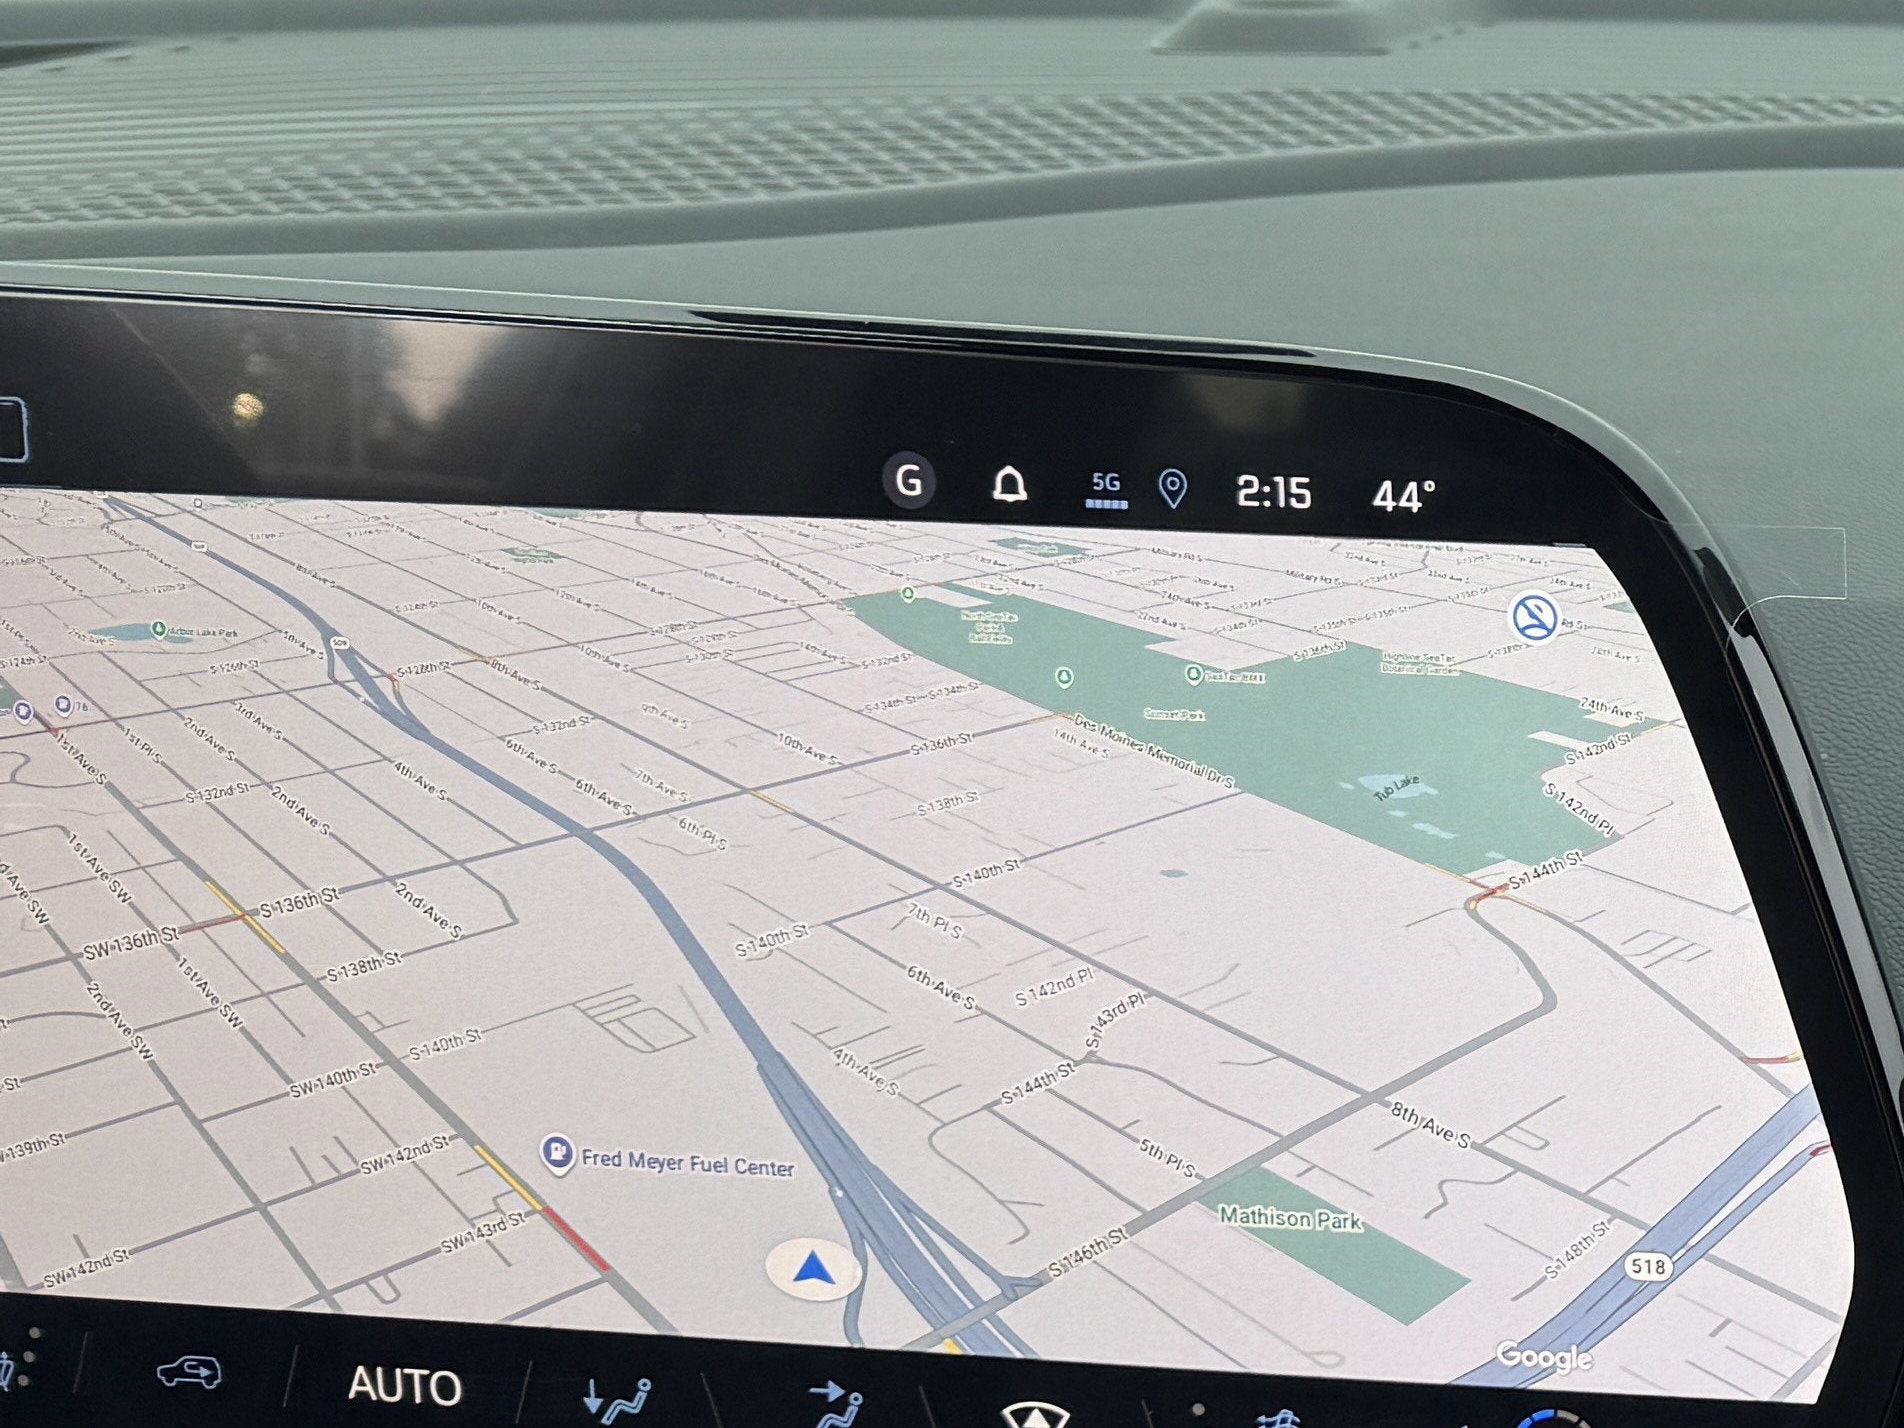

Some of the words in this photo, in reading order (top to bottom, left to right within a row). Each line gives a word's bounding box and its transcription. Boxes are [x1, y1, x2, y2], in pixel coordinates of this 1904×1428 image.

[897, 465, 920, 496] G
[1093, 473, 1120, 492] 5G
[1237, 475, 1311, 510] 2:15
[1372, 479, 1435, 513] 44°
[1581, 697, 1606, 713] 24th
[1611, 704, 1632, 718] Ave
[185, 718, 208, 738] 2nd
[205, 734, 226, 754] Ave
[924, 736, 955, 752] 136th
[957, 732, 972, 745] St
[1075, 714, 1096, 733] Des
[1100, 724, 1144, 752] Moines
[1148, 744, 1207, 777] Memorial
[1208, 768, 1223, 785] Dr
[1223, 776, 1234, 790] S
[1579, 740, 1616, 761] 142nd
[1617, 734, 1631, 746] St
[56, 733, 74, 758] 1st
[72, 750, 96, 776] Ave
[199, 784, 233, 801] 132nd
[237, 782, 249, 794] St
[394, 761, 414, 779] 4th
[414, 775, 436, 792] Ave
[575, 779, 596, 795] 6th
[598, 790, 621, 808] Ave
[1373, 786, 1395, 802] Tub
[1393, 775, 1420, 791] Lake
[271, 786, 297, 809] 2nd
[295, 806, 320, 828] Ave
[1557, 790, 1597, 825] 142nd
[1597, 818, 1616, 837] Pl
[679, 818, 699, 835] 6th
[703, 828, 716, 843] Pl
[69, 834, 88, 857] 1st
[86, 850, 109, 883] Ave
[108, 879, 131, 905] SW
[967, 864, 1002, 884] 140th
[1004, 859, 1021, 873] St
[1522, 859, 1564, 885] 144th
[1566, 851, 1584, 866] St
[7, 871, 29, 899] Ave
[27, 899, 50, 925] SW
[275, 891, 320, 915] 136th
[321, 887, 338, 904] St
[396, 883, 426, 910] 2nd
[424, 905, 450, 930] Ave
[907, 903, 930, 924] 7th
[934, 915, 949, 932] Pl
[83, 942, 109, 961] SW
[114, 930, 159, 953] 136th
[161, 926, 178, 942] St
[750, 930, 790, 952] 140th
[793, 924, 808, 938] St
[342, 957, 381, 978] 138th
[385, 952, 401, 966] St
[178, 956, 198, 982] 1st
[195, 973, 220, 1006] Ave
[219, 1003, 244, 1029] SW
[907, 965, 933, 987] 6th
[936, 982, 962, 1004] Ave
[1030, 977, 1075, 1001] 142nd
[1078, 967, 1093, 983] Pl
[87, 981, 112, 1011] 2nd
[108, 1007, 133, 1038] Ave
[132, 1035, 154, 1061] SW
[1089, 1003, 1127, 1036] 143rd
[1128, 993, 1144, 1009] Pl
[424, 1036, 463, 1057] 140th
[465, 1029, 482, 1043] St
[289, 1083, 313, 1099] SW
[317, 1068, 357, 1091] 140th
[358, 1062, 376, 1076] St
[832, 1047, 857, 1069] 4th
[859, 1064, 887, 1086] Ave
[1015, 1072, 1058, 1099] 144th
[1058, 1061, 1075, 1077] St
[4, 1078, 20, 1090] St
[1390, 1101, 1420, 1129] 8th
[1422, 1116, 1456, 1142] Ave
[10, 1139, 46, 1159] 139th
[49, 1133, 66, 1147] St
[360, 1158, 384, 1175] SW
[388, 1144, 431, 1166] 142nd
[432, 1136, 449, 1149] St
[582, 1149, 622, 1167] Fred
[628, 1152, 684, 1173] Meyer
[690, 1156, 728, 1173] Fuel
[735, 1158, 795, 1177] Center
[1140, 1138, 1164, 1161] 5th
[1166, 1151, 1182, 1171] Pl
[440, 1238, 466, 1256] SW
[467, 1221, 506, 1244] 143rd
[507, 1212, 525, 1226] St
[1219, 1205, 1311, 1228] Mathison
[1316, 1210, 1363, 1229] Park
[1064, 1237, 1108, 1268] 146th
[1108, 1227, 1129, 1248] St
[1556, 1234, 1595, 1269] 148th
[1592, 1220, 1611, 1238] St
[43, 1273, 66, 1288] SW
[69, 1254, 111, 1278] 142nd
[112, 1249, 129, 1263] St
[1631, 1258, 1666, 1274] 518
[1496, 1340, 1593, 1375] Google
[348, 1366, 462, 1406] AUTO
